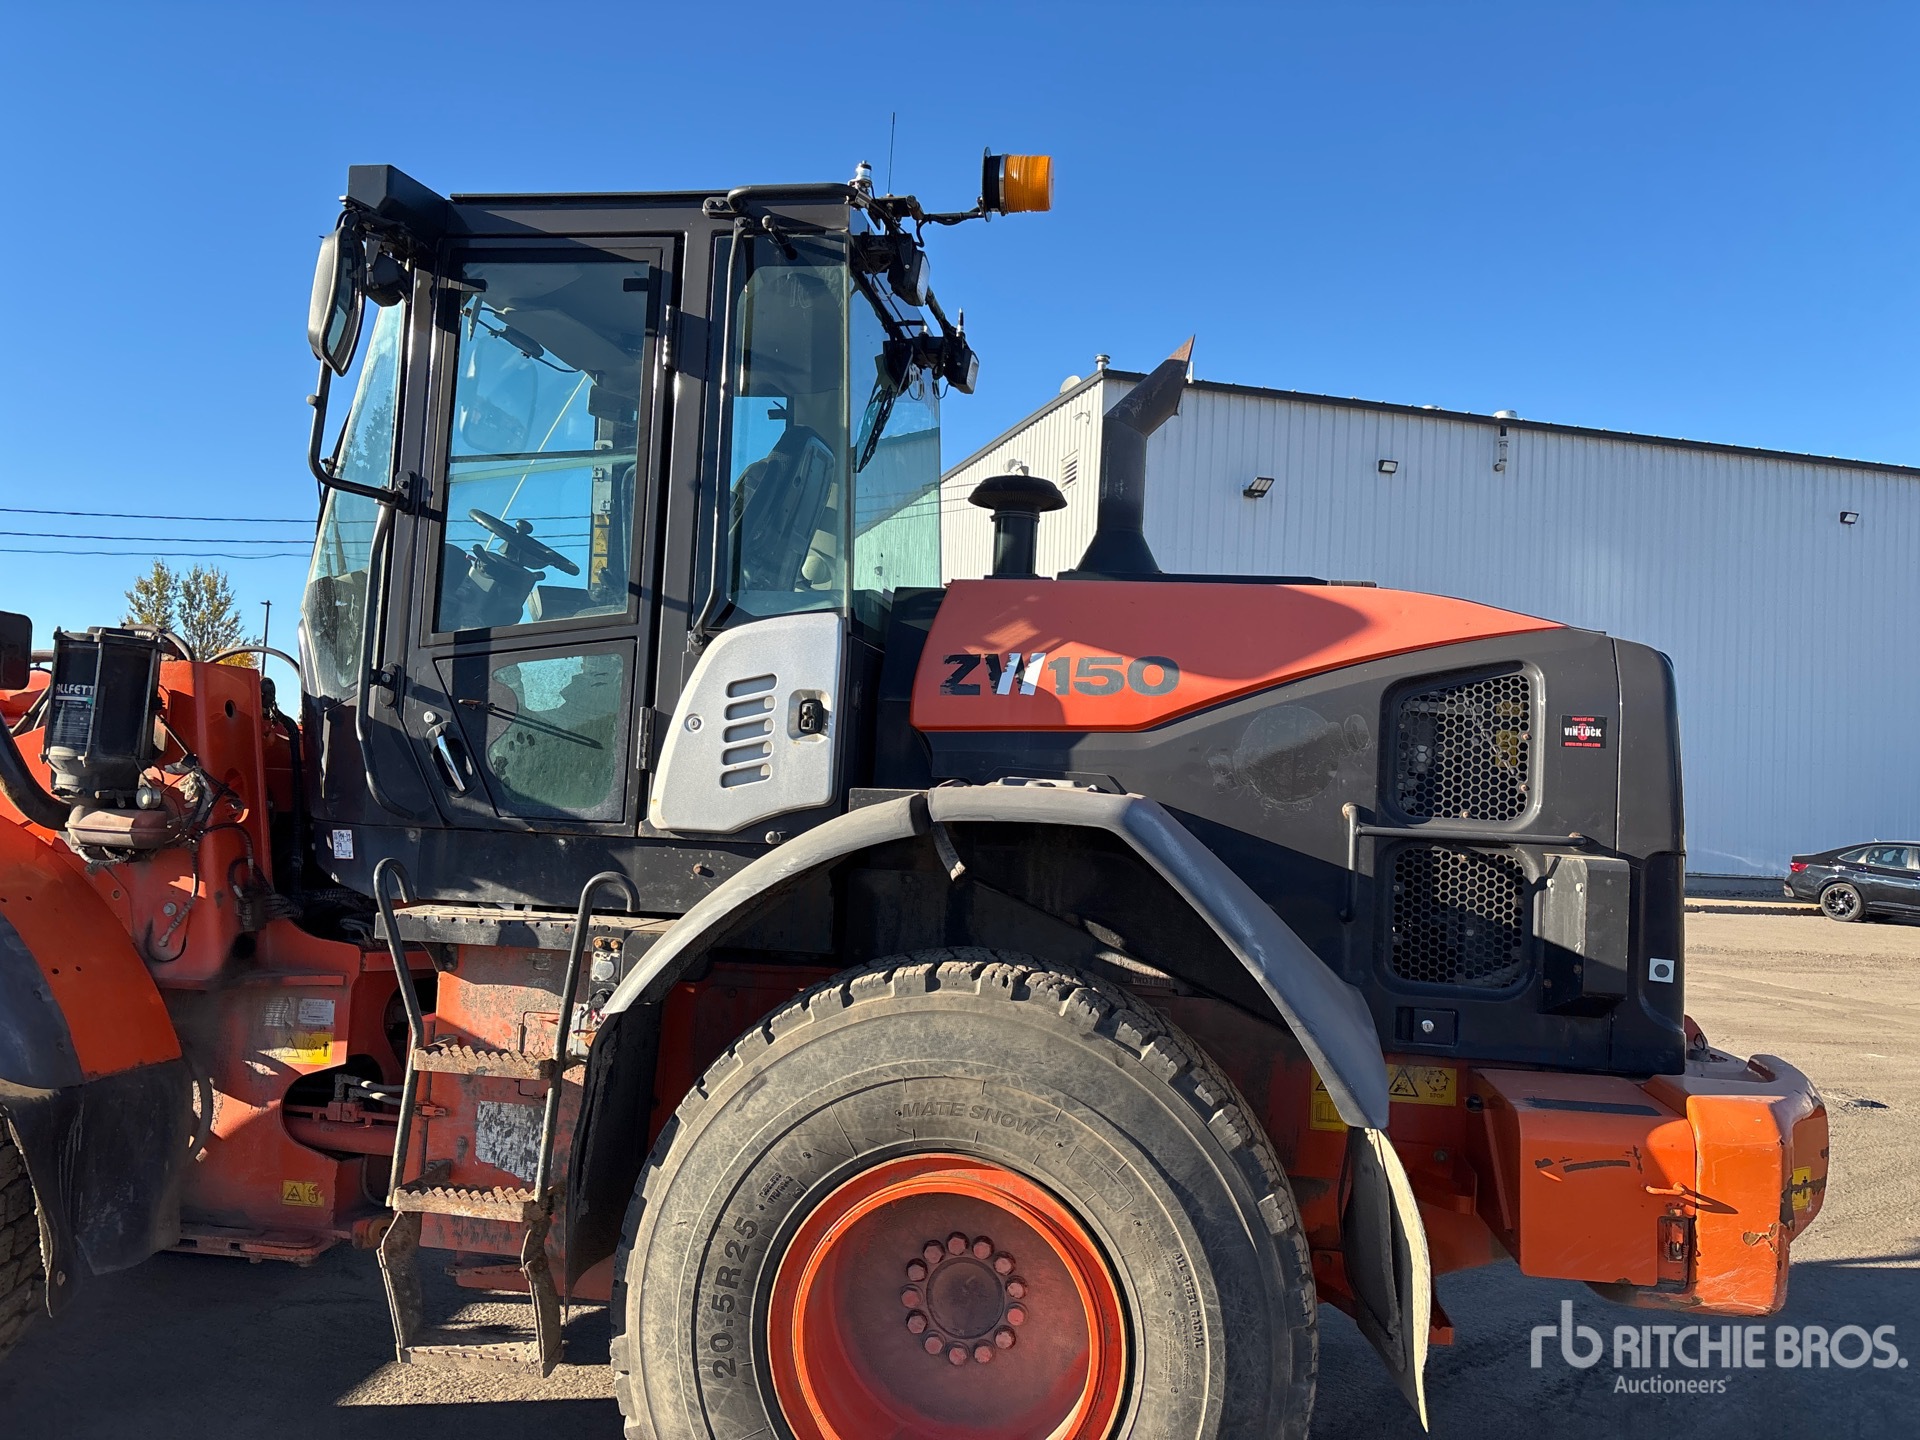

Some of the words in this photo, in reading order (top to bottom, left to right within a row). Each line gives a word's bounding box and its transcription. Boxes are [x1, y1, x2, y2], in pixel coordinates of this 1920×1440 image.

[939, 652, 1180, 696] ZW150
[1564, 727, 1602, 737] VIN-LOCK
[902, 1101, 966, 1118] MATE
[709, 1216, 759, 1379] 20.5R25
[1173, 1252, 1187, 1272] ALL
[1182, 1274, 1198, 1306] STEEL
[1190, 1310, 1205, 1349] RADIAL
